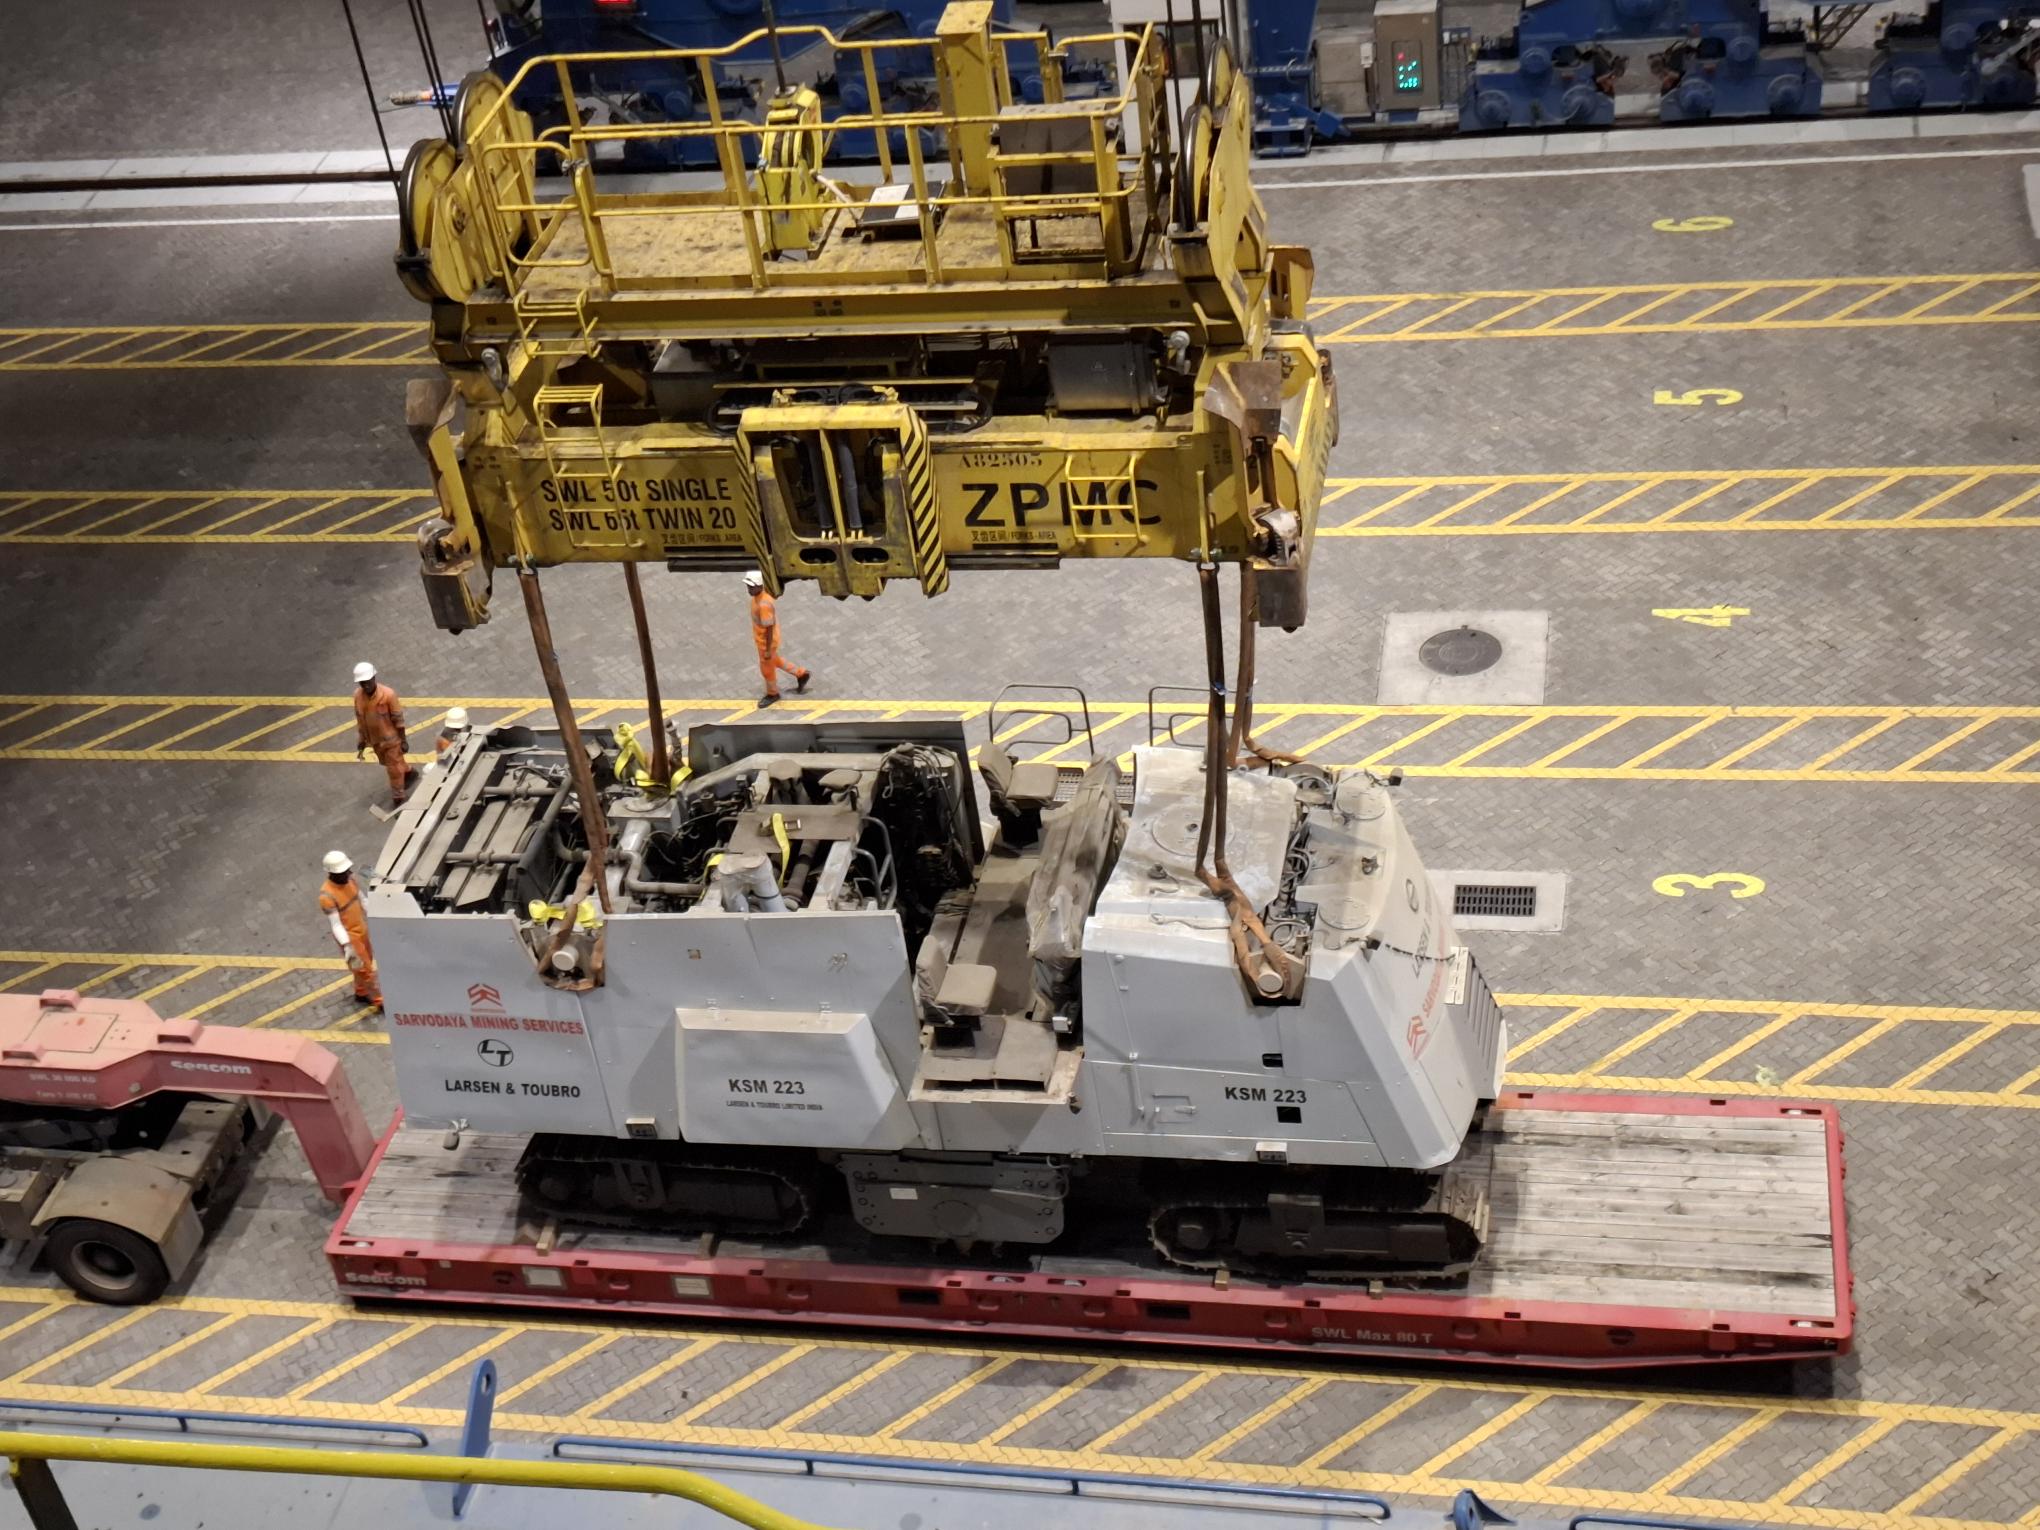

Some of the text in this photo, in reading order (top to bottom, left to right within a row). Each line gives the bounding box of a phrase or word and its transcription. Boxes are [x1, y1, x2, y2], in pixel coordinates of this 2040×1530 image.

[1653, 388, 1743, 407] 5
[540, 478, 732, 502] SWL 50t SINGLE
[962, 479, 1162, 527] ZPMC
[549, 508, 600, 531] SWL
[643, 508, 704, 530] TWIN
[708, 507, 736, 529] 20
[1652, 606, 1751, 628] 4
[1652, 873, 1766, 899] 3
[394, 1013, 584, 1035] SARVODAYA MINING SERVICES
[445, 1079, 581, 1098] LARSEN & TOUBRO
[729, 1079, 805, 1095] KSM 223
[1225, 1087, 1306, 1103] KSM 223
[345, 1272, 427, 1286] Seacom
[1311, 1327, 1352, 1339] SWL
[1356, 1329, 1391, 1341] Max
[1421, 1333, 1433, 1344] T
